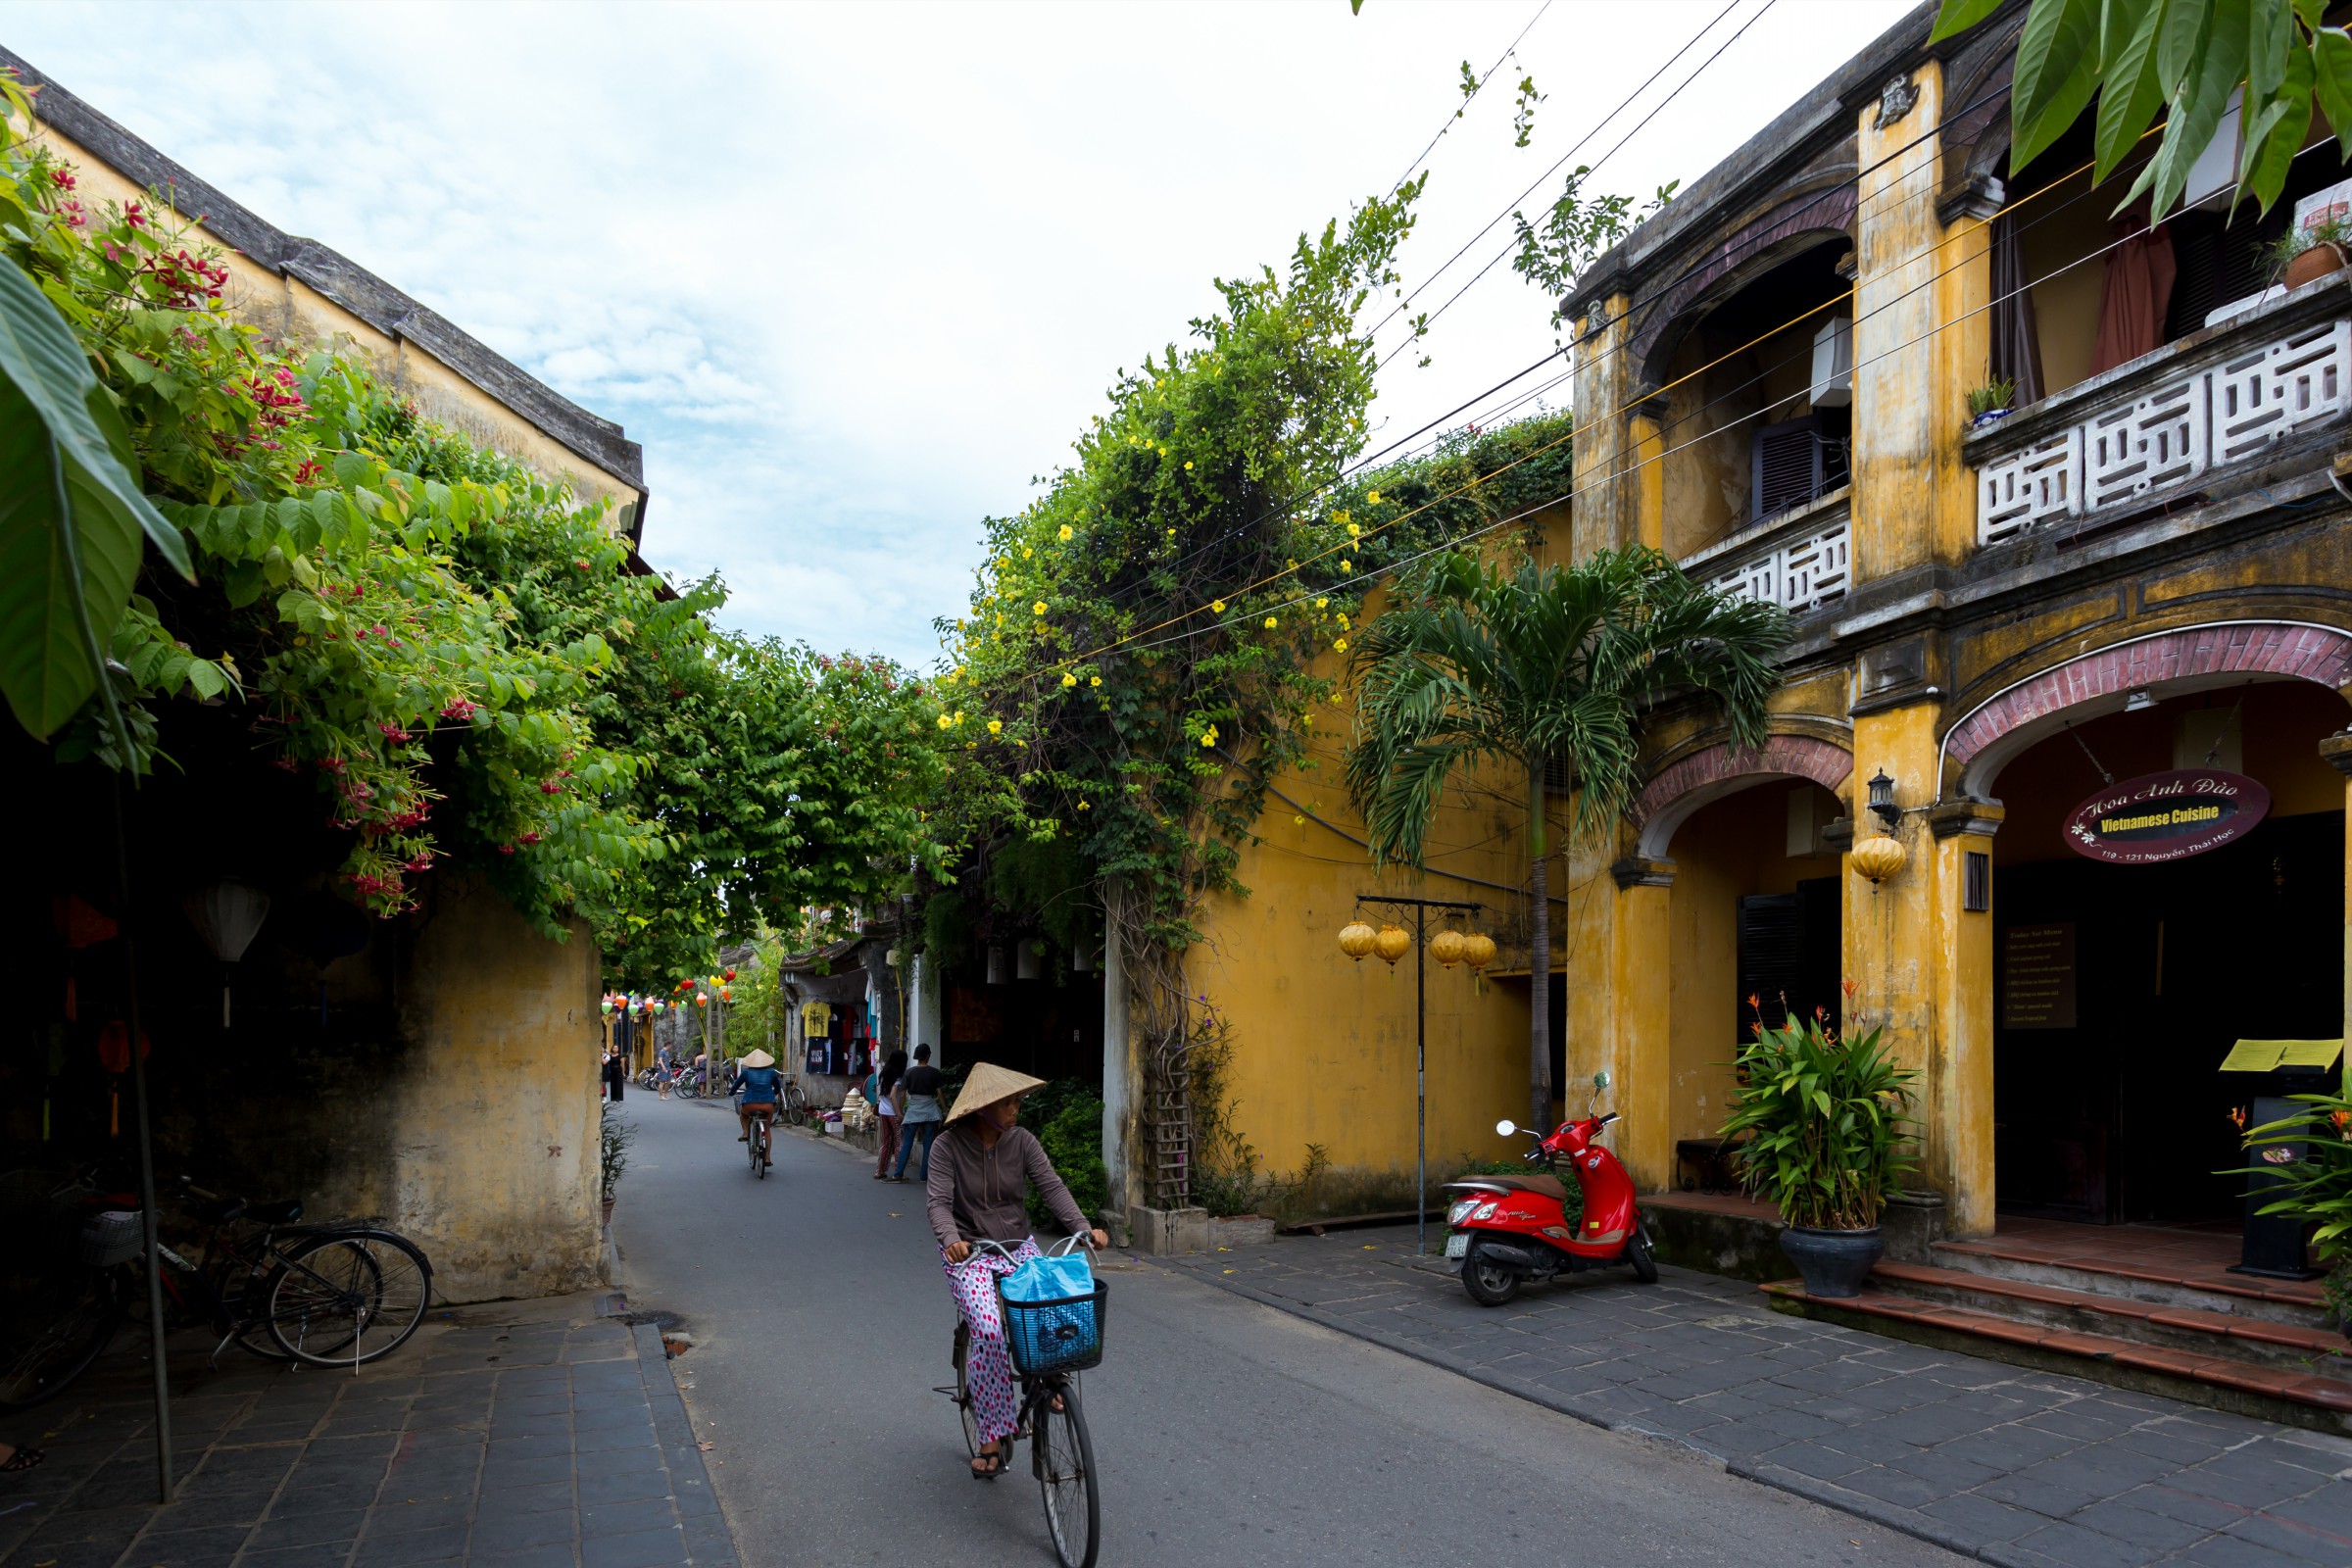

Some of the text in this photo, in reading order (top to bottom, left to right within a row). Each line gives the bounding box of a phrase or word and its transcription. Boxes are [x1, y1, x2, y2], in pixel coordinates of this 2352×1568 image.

[2085, 778, 2239, 818] Hoa Anh Đào
[2100, 806, 2220, 833] Vietnamese Cuisine
[2101, 850, 2117, 859] 119
[2187, 840, 2212, 853] Thái
[2212, 828, 2234, 845] Học
